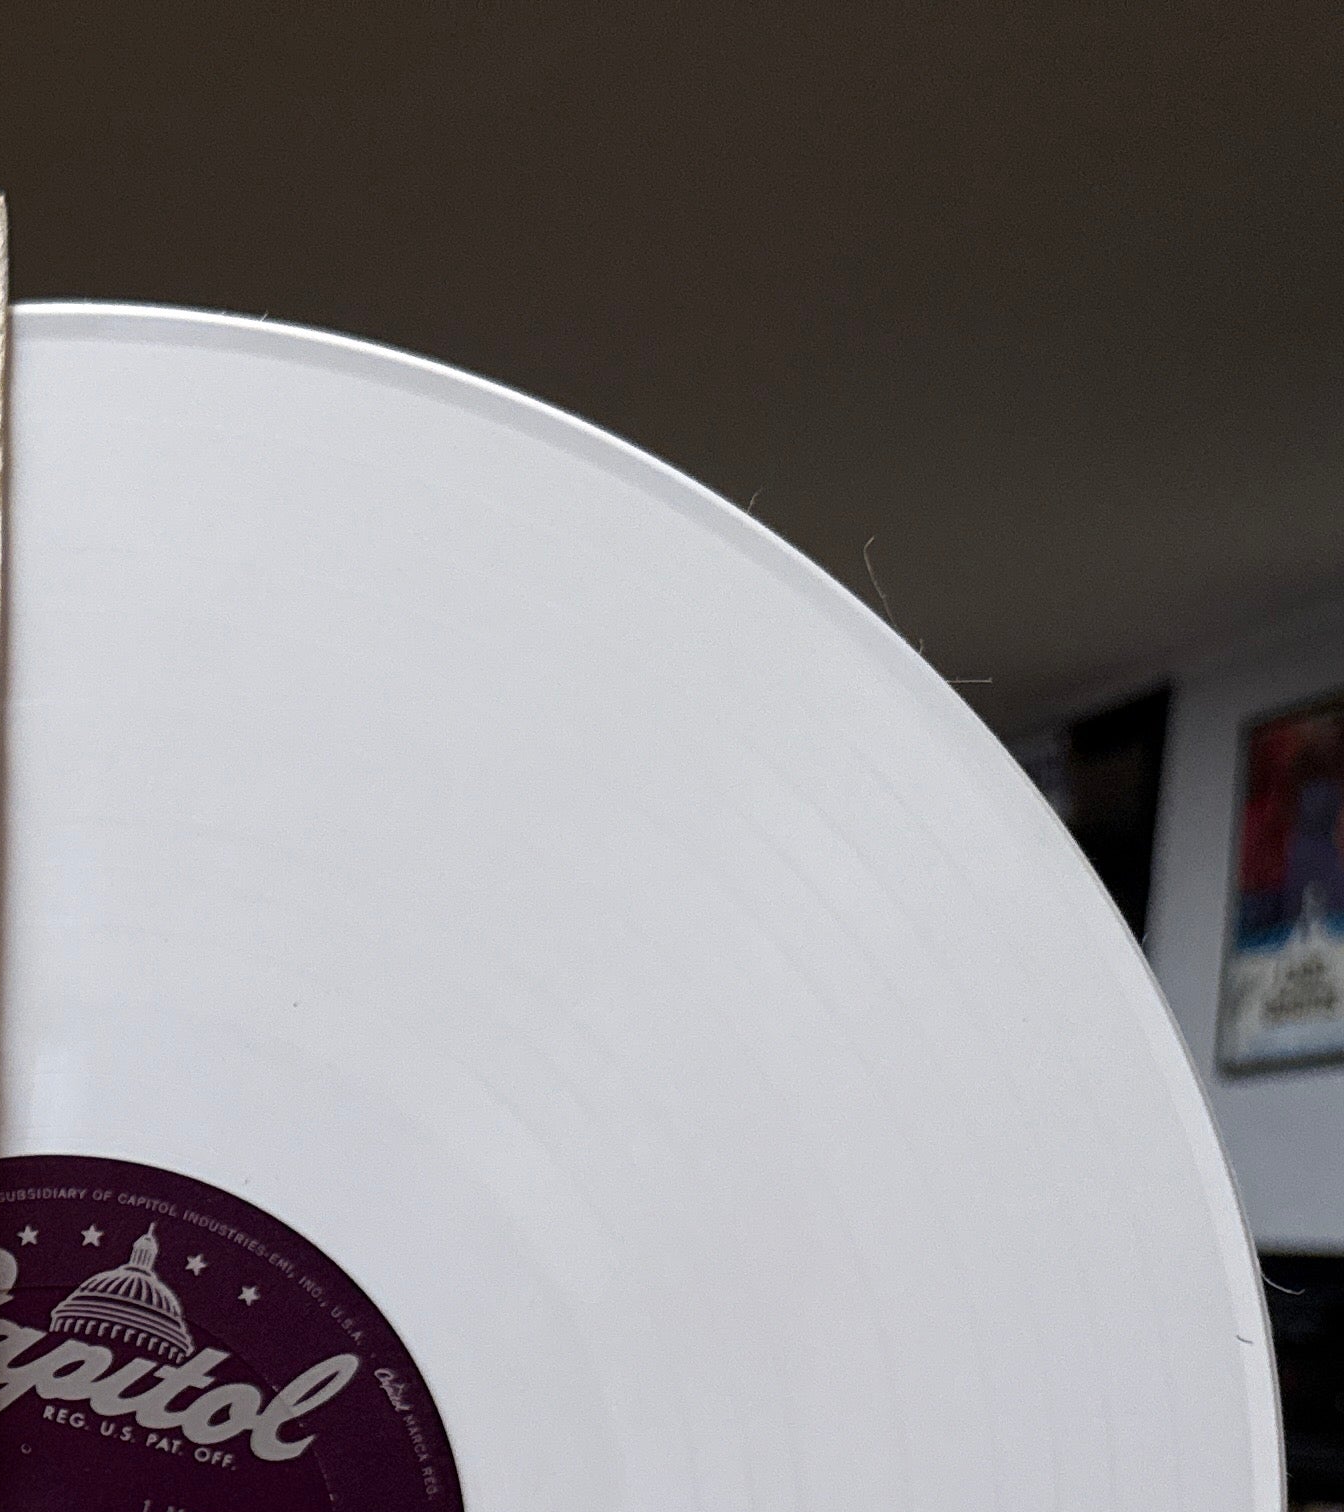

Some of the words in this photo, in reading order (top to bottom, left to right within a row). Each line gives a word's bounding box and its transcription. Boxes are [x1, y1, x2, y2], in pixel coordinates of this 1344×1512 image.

[92, 1189, 114, 1201] OF
[117, 1192, 178, 1217] CAPITOL
[42, 1405, 90, 1432] REG.
[100, 1421, 136, 1444] U.S.
[146, 1432, 184, 1457] PAT.
[194, 1445, 237, 1471] OFF.
[403, 1413, 430, 1463] MARCA
